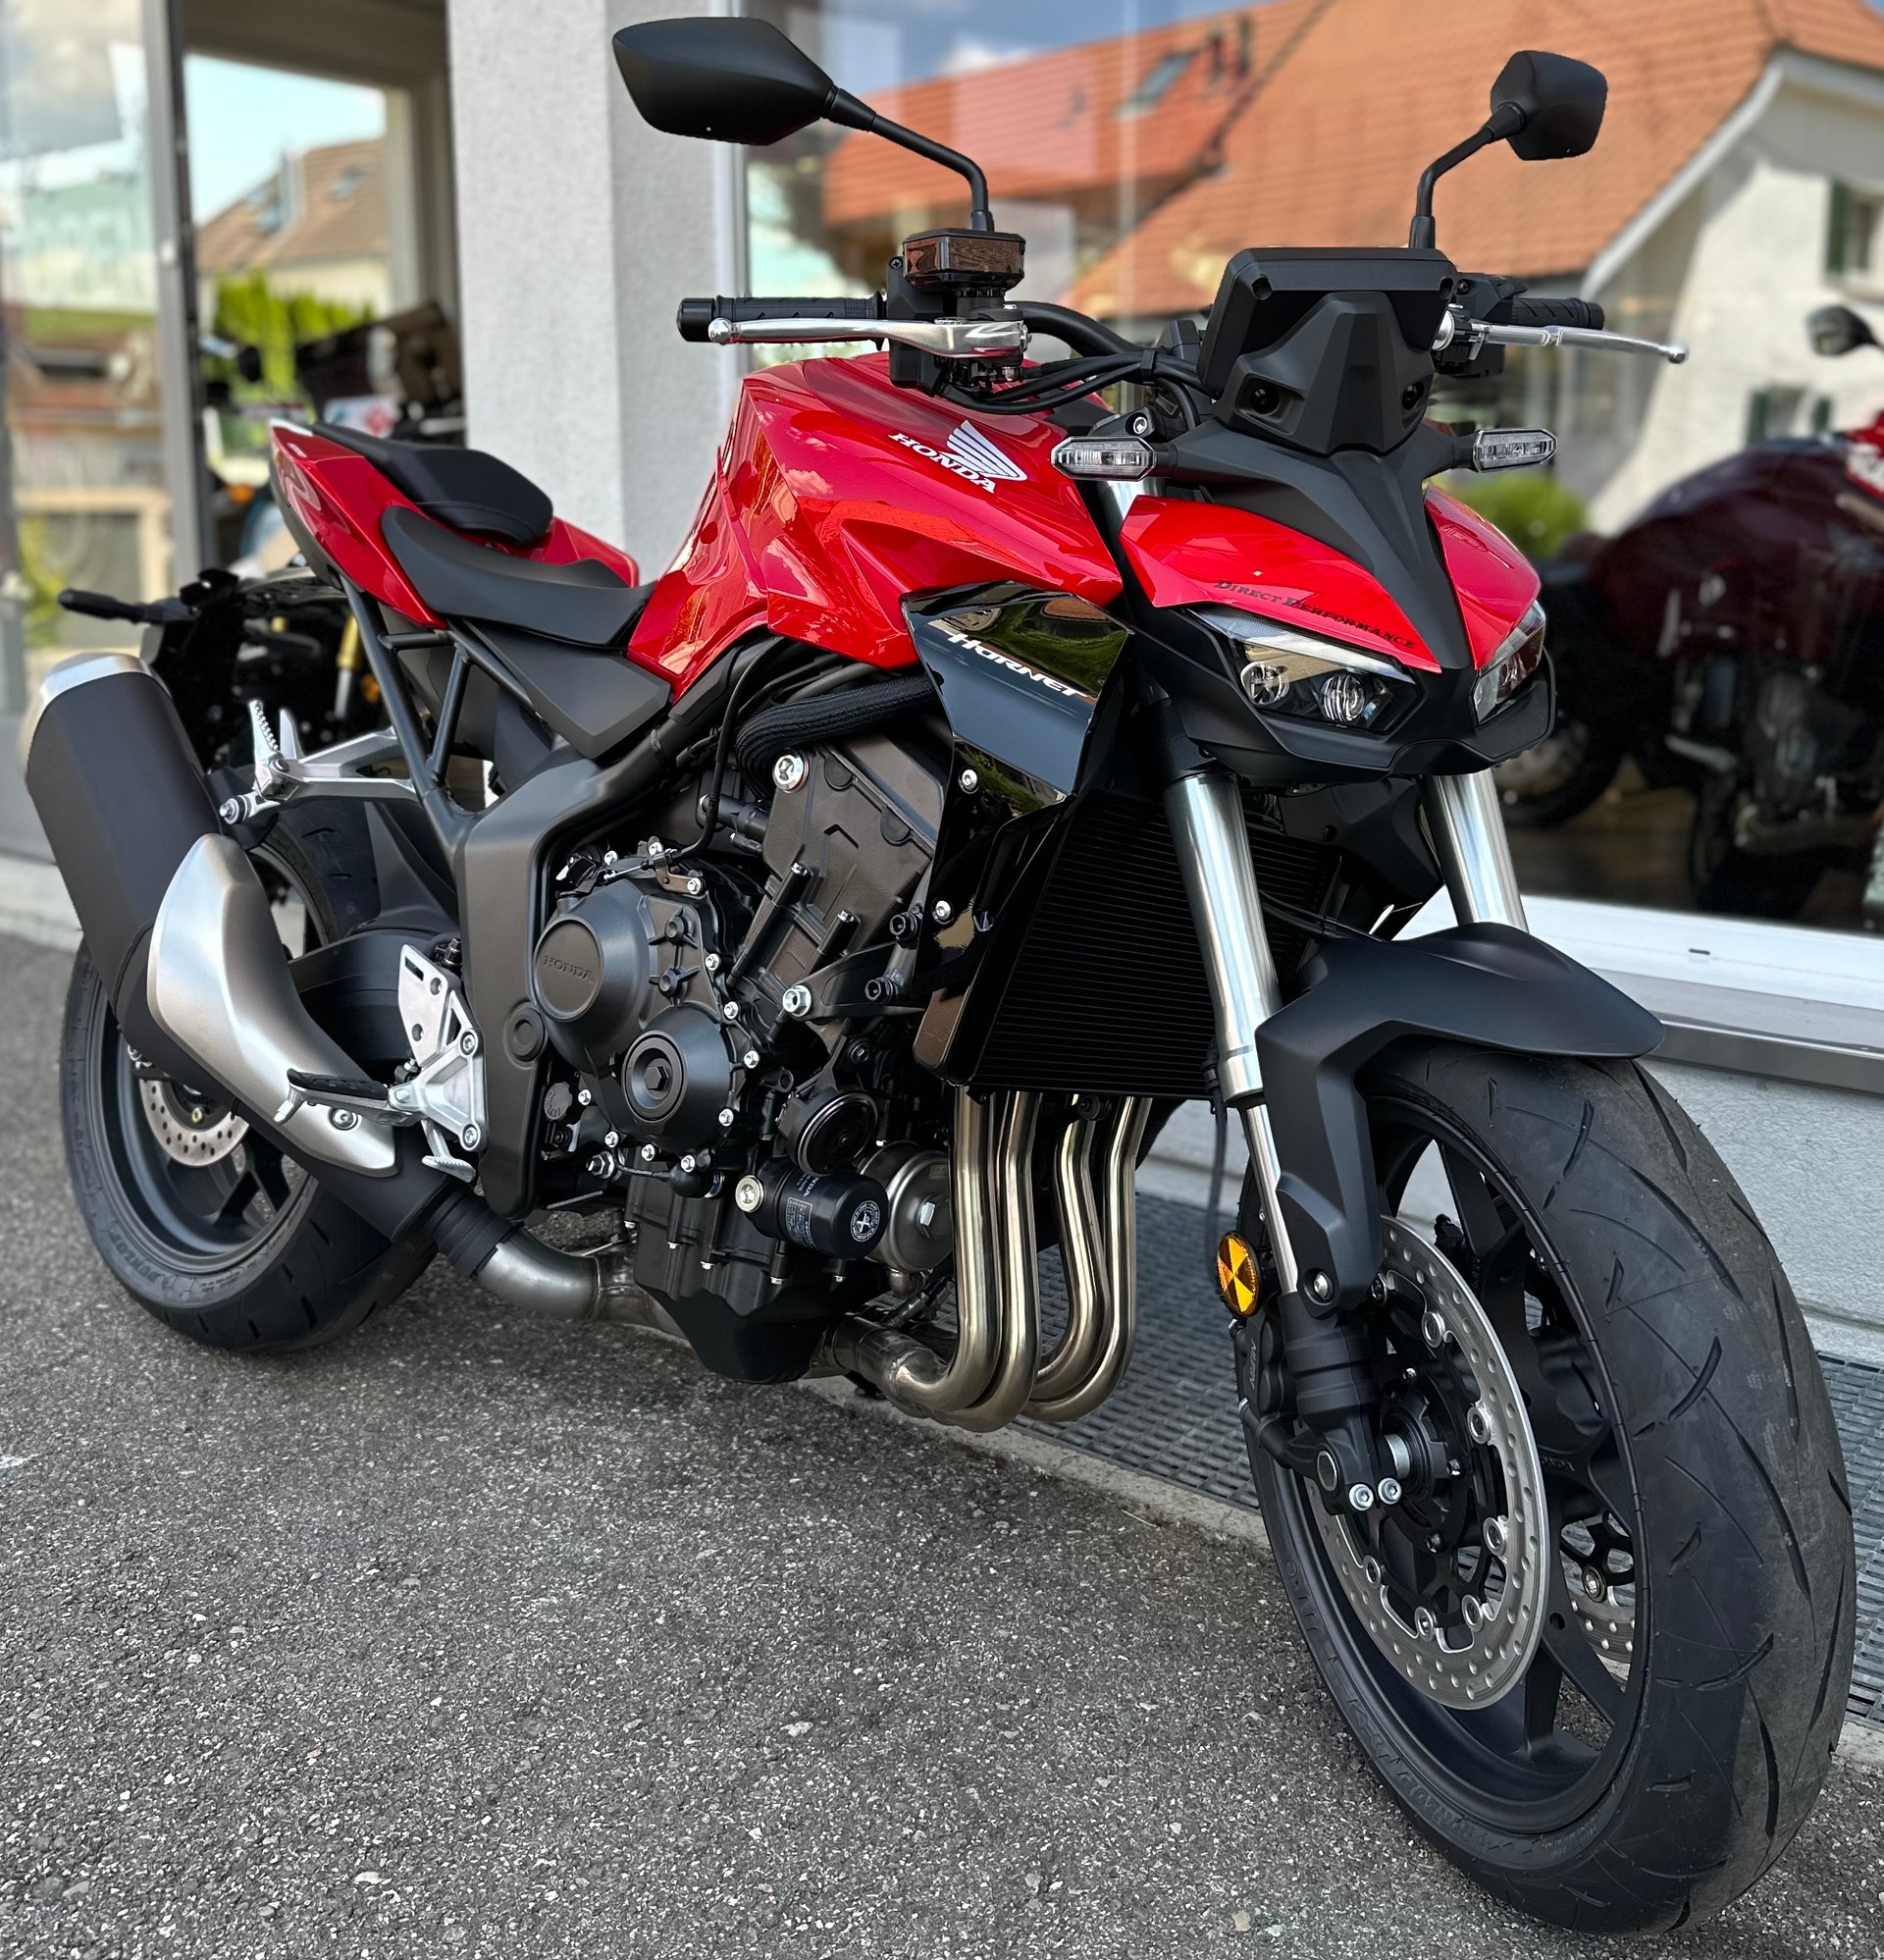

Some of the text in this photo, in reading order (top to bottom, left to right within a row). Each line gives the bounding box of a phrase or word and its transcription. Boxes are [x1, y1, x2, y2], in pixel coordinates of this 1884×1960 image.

[888, 433, 996, 494] HONDA
[1216, 581, 1415, 649] DIRECT PERFORMANCE
[948, 633, 1088, 698] HORNET
[543, 955, 593, 982] HONDA
